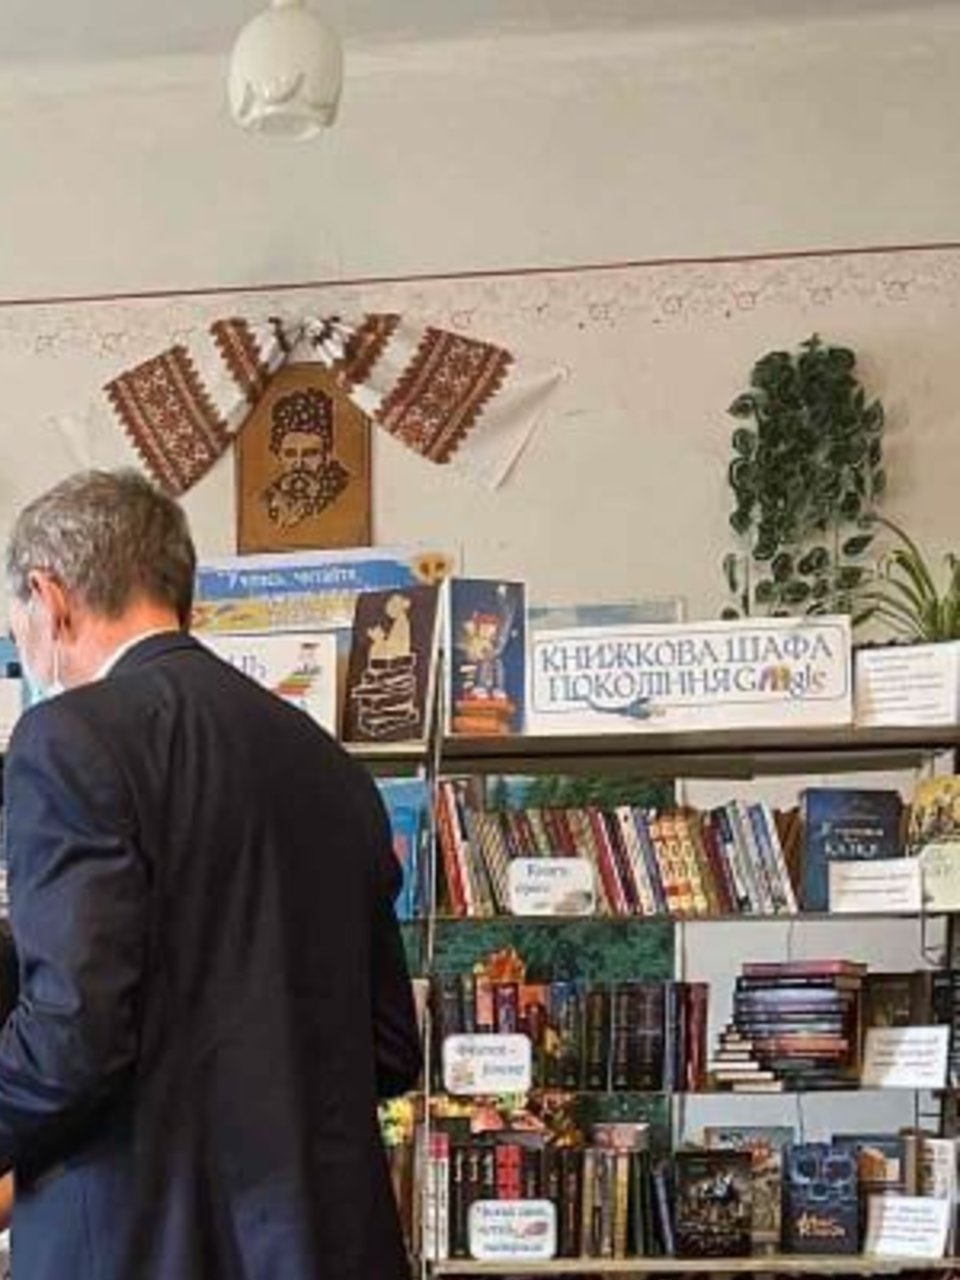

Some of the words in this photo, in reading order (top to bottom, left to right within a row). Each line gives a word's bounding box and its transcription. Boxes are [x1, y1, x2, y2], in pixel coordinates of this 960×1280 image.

[541, 638, 720, 673] КНИЖКОВА
[727, 632, 834, 663] ШАФА
[549, 666, 732, 702] ПОКОЛІННЯ
